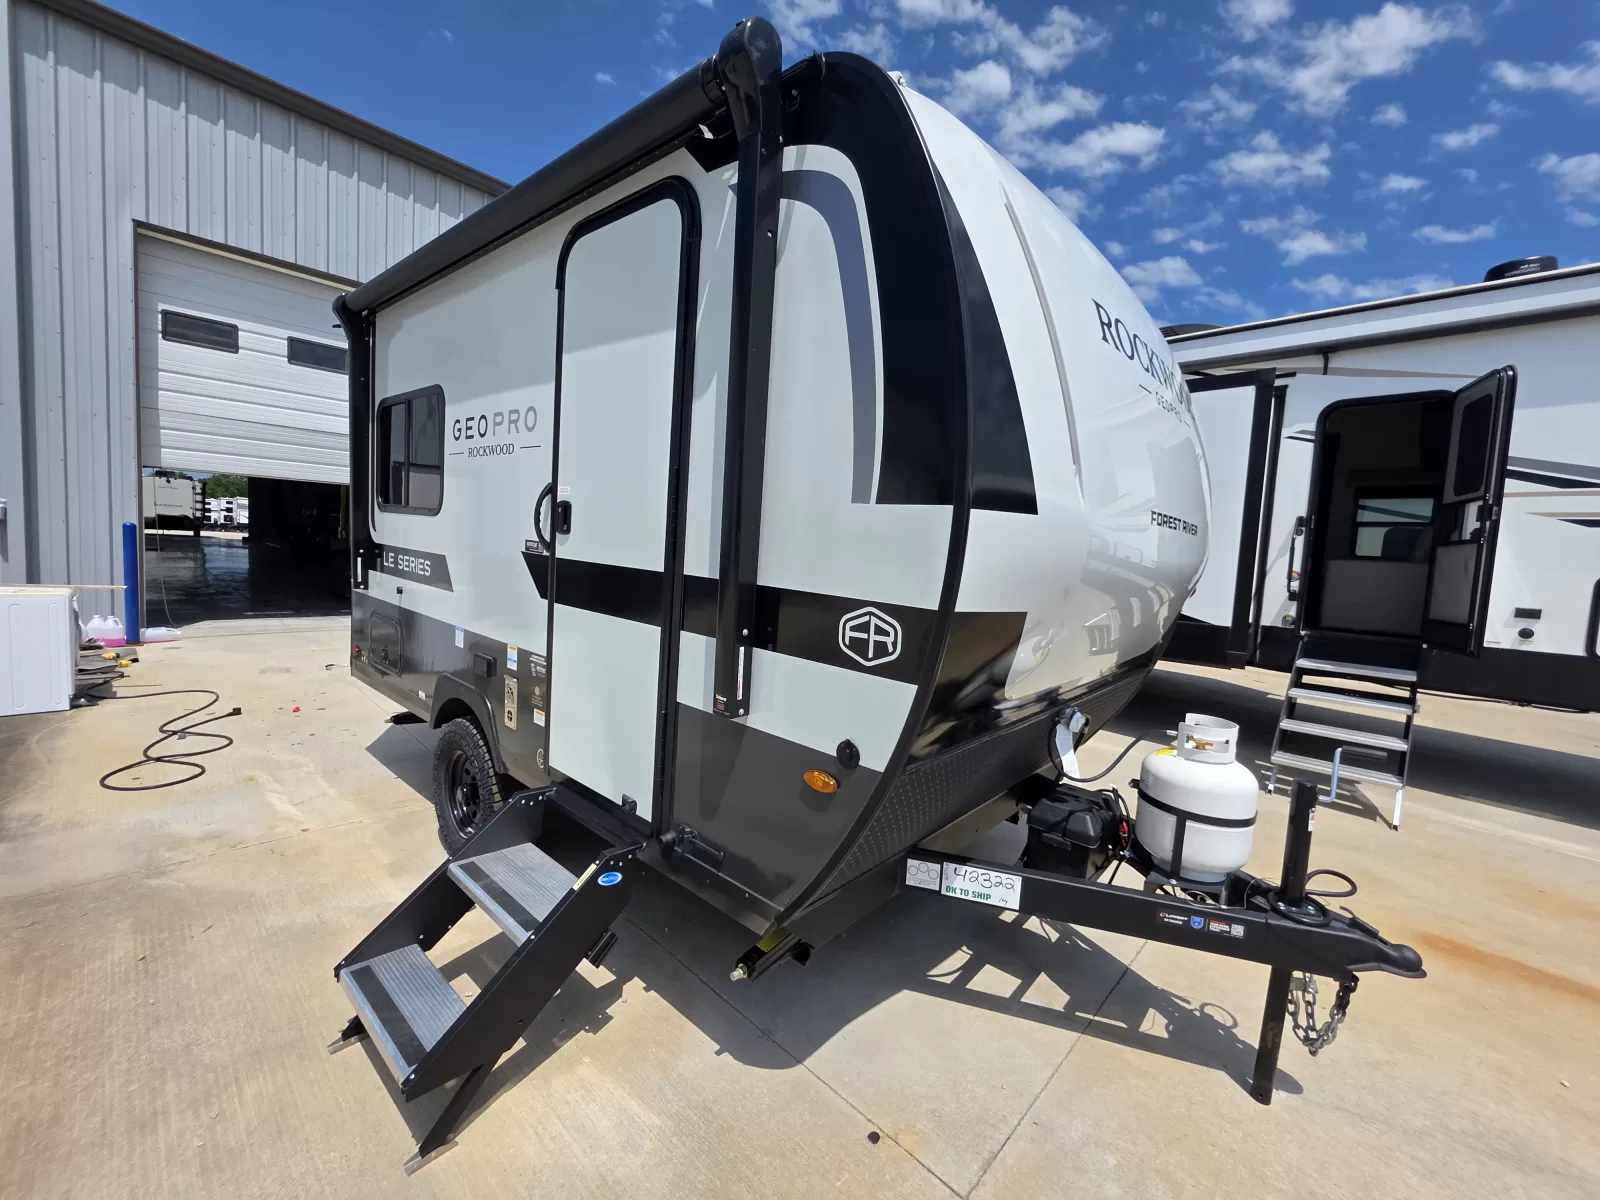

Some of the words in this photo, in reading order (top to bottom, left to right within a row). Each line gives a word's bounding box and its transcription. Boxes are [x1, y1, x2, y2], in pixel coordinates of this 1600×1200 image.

[452, 405, 538, 441] GEOPRO
[468, 443, 515, 458] ROCKWOOD
[1150, 510, 1182, 531] FOREST
[1182, 519, 1198, 537] RIVER
[383, 551, 395, 568] LE
[397, 554, 431, 576] SERIES
[954, 866, 1016, 893] 42322
[945, 885, 958, 895] OK
[959, 887, 970, 897] TO
[971, 890, 992, 901] SHIP
